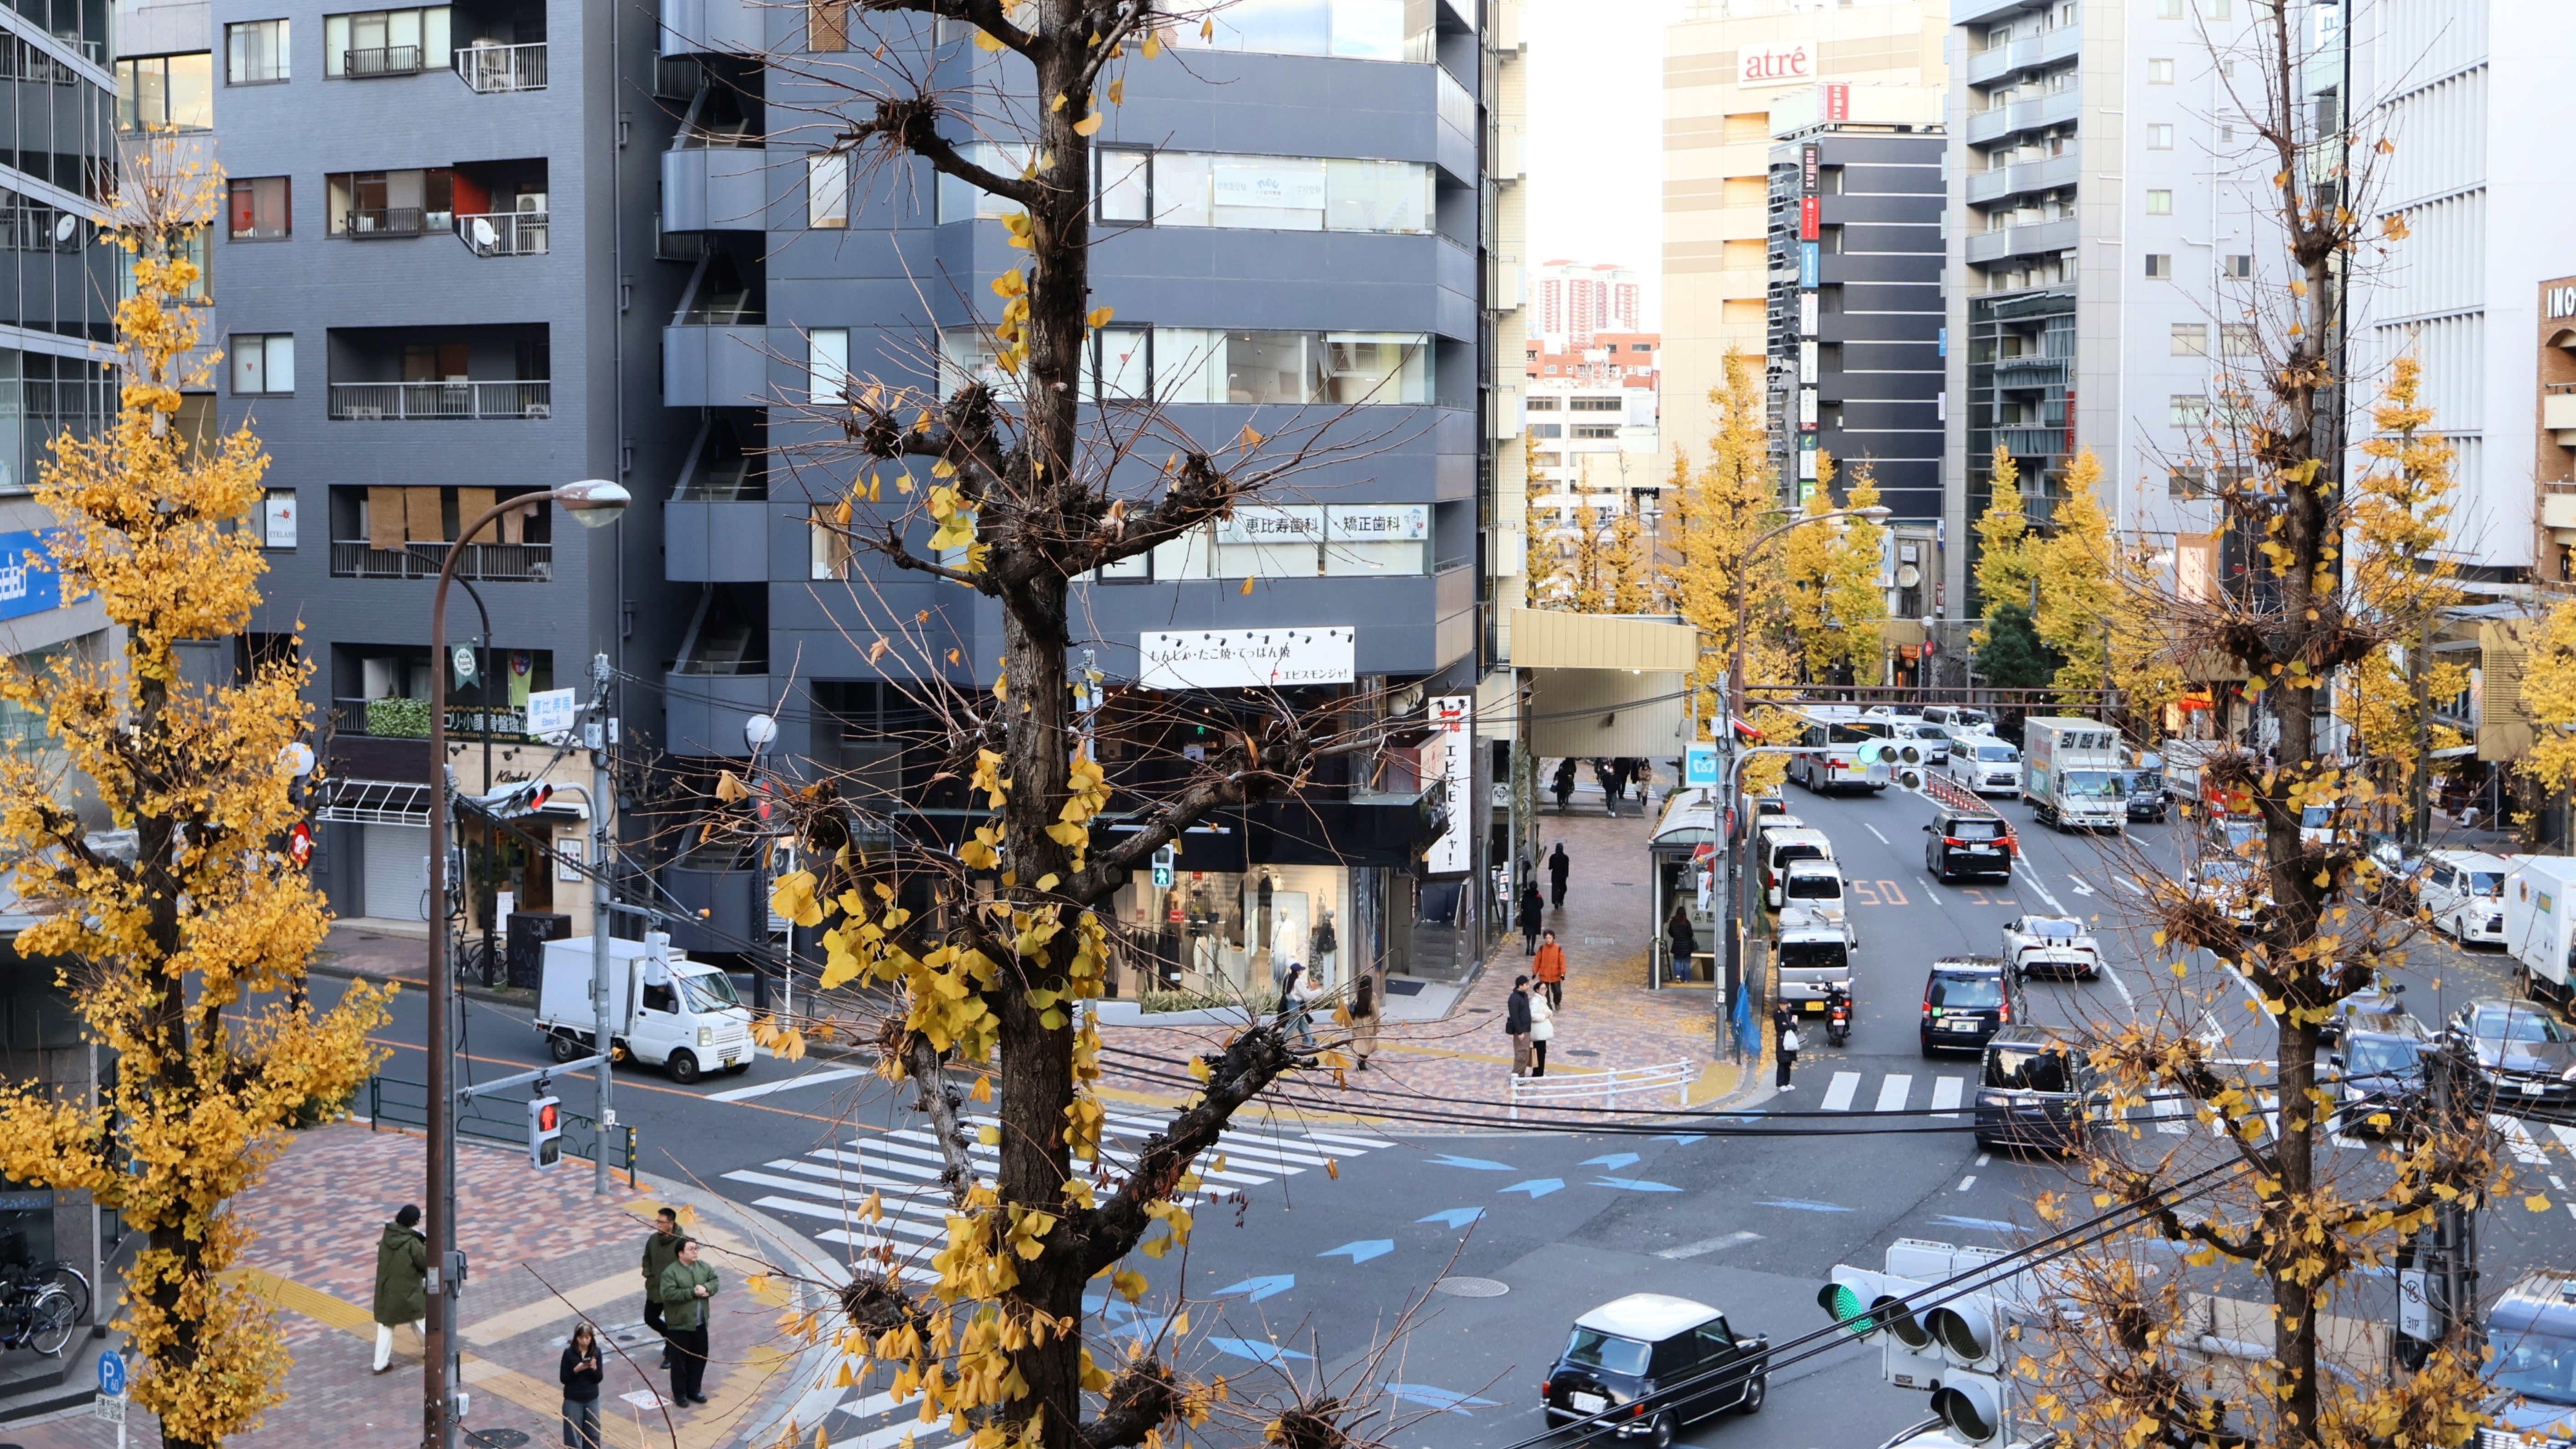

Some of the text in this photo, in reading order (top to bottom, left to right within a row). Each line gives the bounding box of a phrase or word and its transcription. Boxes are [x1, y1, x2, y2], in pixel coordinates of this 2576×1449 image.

[1746, 46, 1807, 78] atré
[2547, 286, 2576, 318] INO
[1802, 486, 1816, 500] P
[533, 696, 571, 715] 恵比寿南
[1852, 880, 1909, 905] 50
[103, 1361, 114, 1389] P
